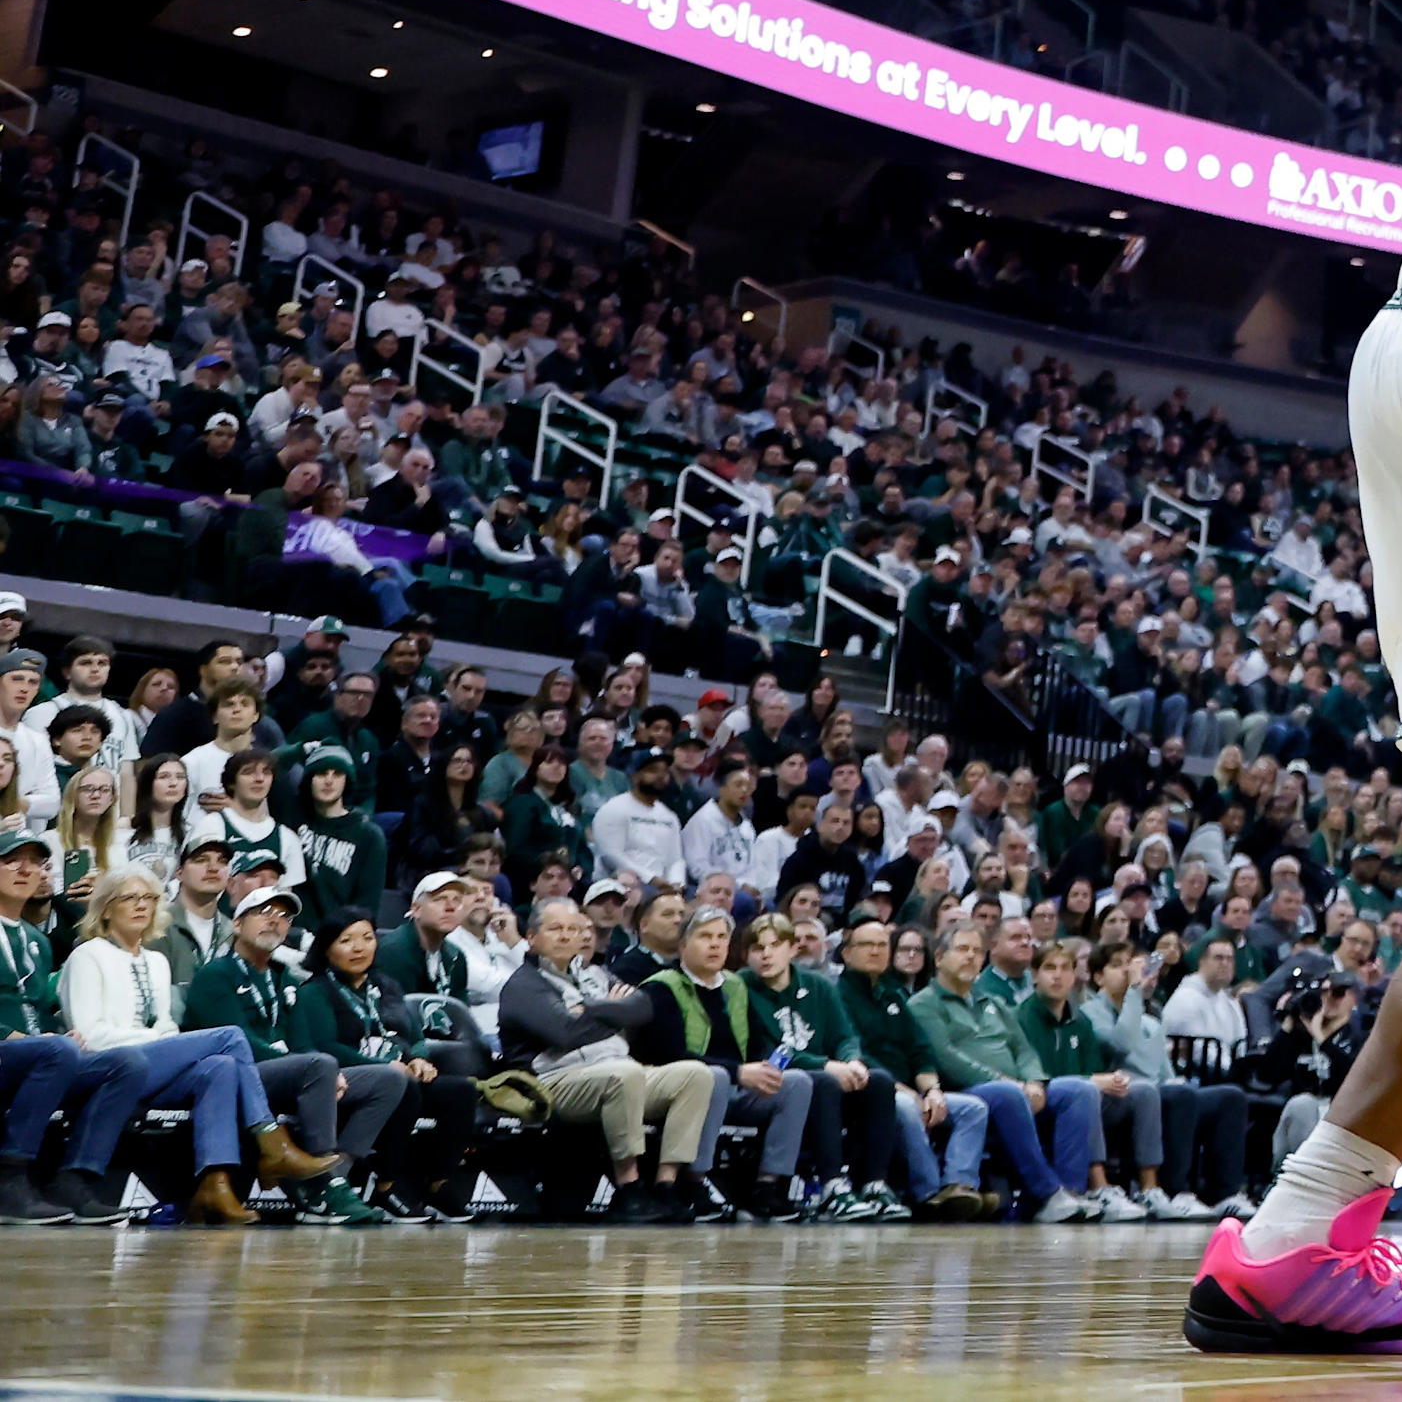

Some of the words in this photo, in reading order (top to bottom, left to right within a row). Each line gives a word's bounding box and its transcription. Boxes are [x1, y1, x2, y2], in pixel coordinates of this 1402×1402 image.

[877, 57, 920, 101] at
[925, 70, 1035, 144] Every
[1037, 101, 1148, 165] Level.
